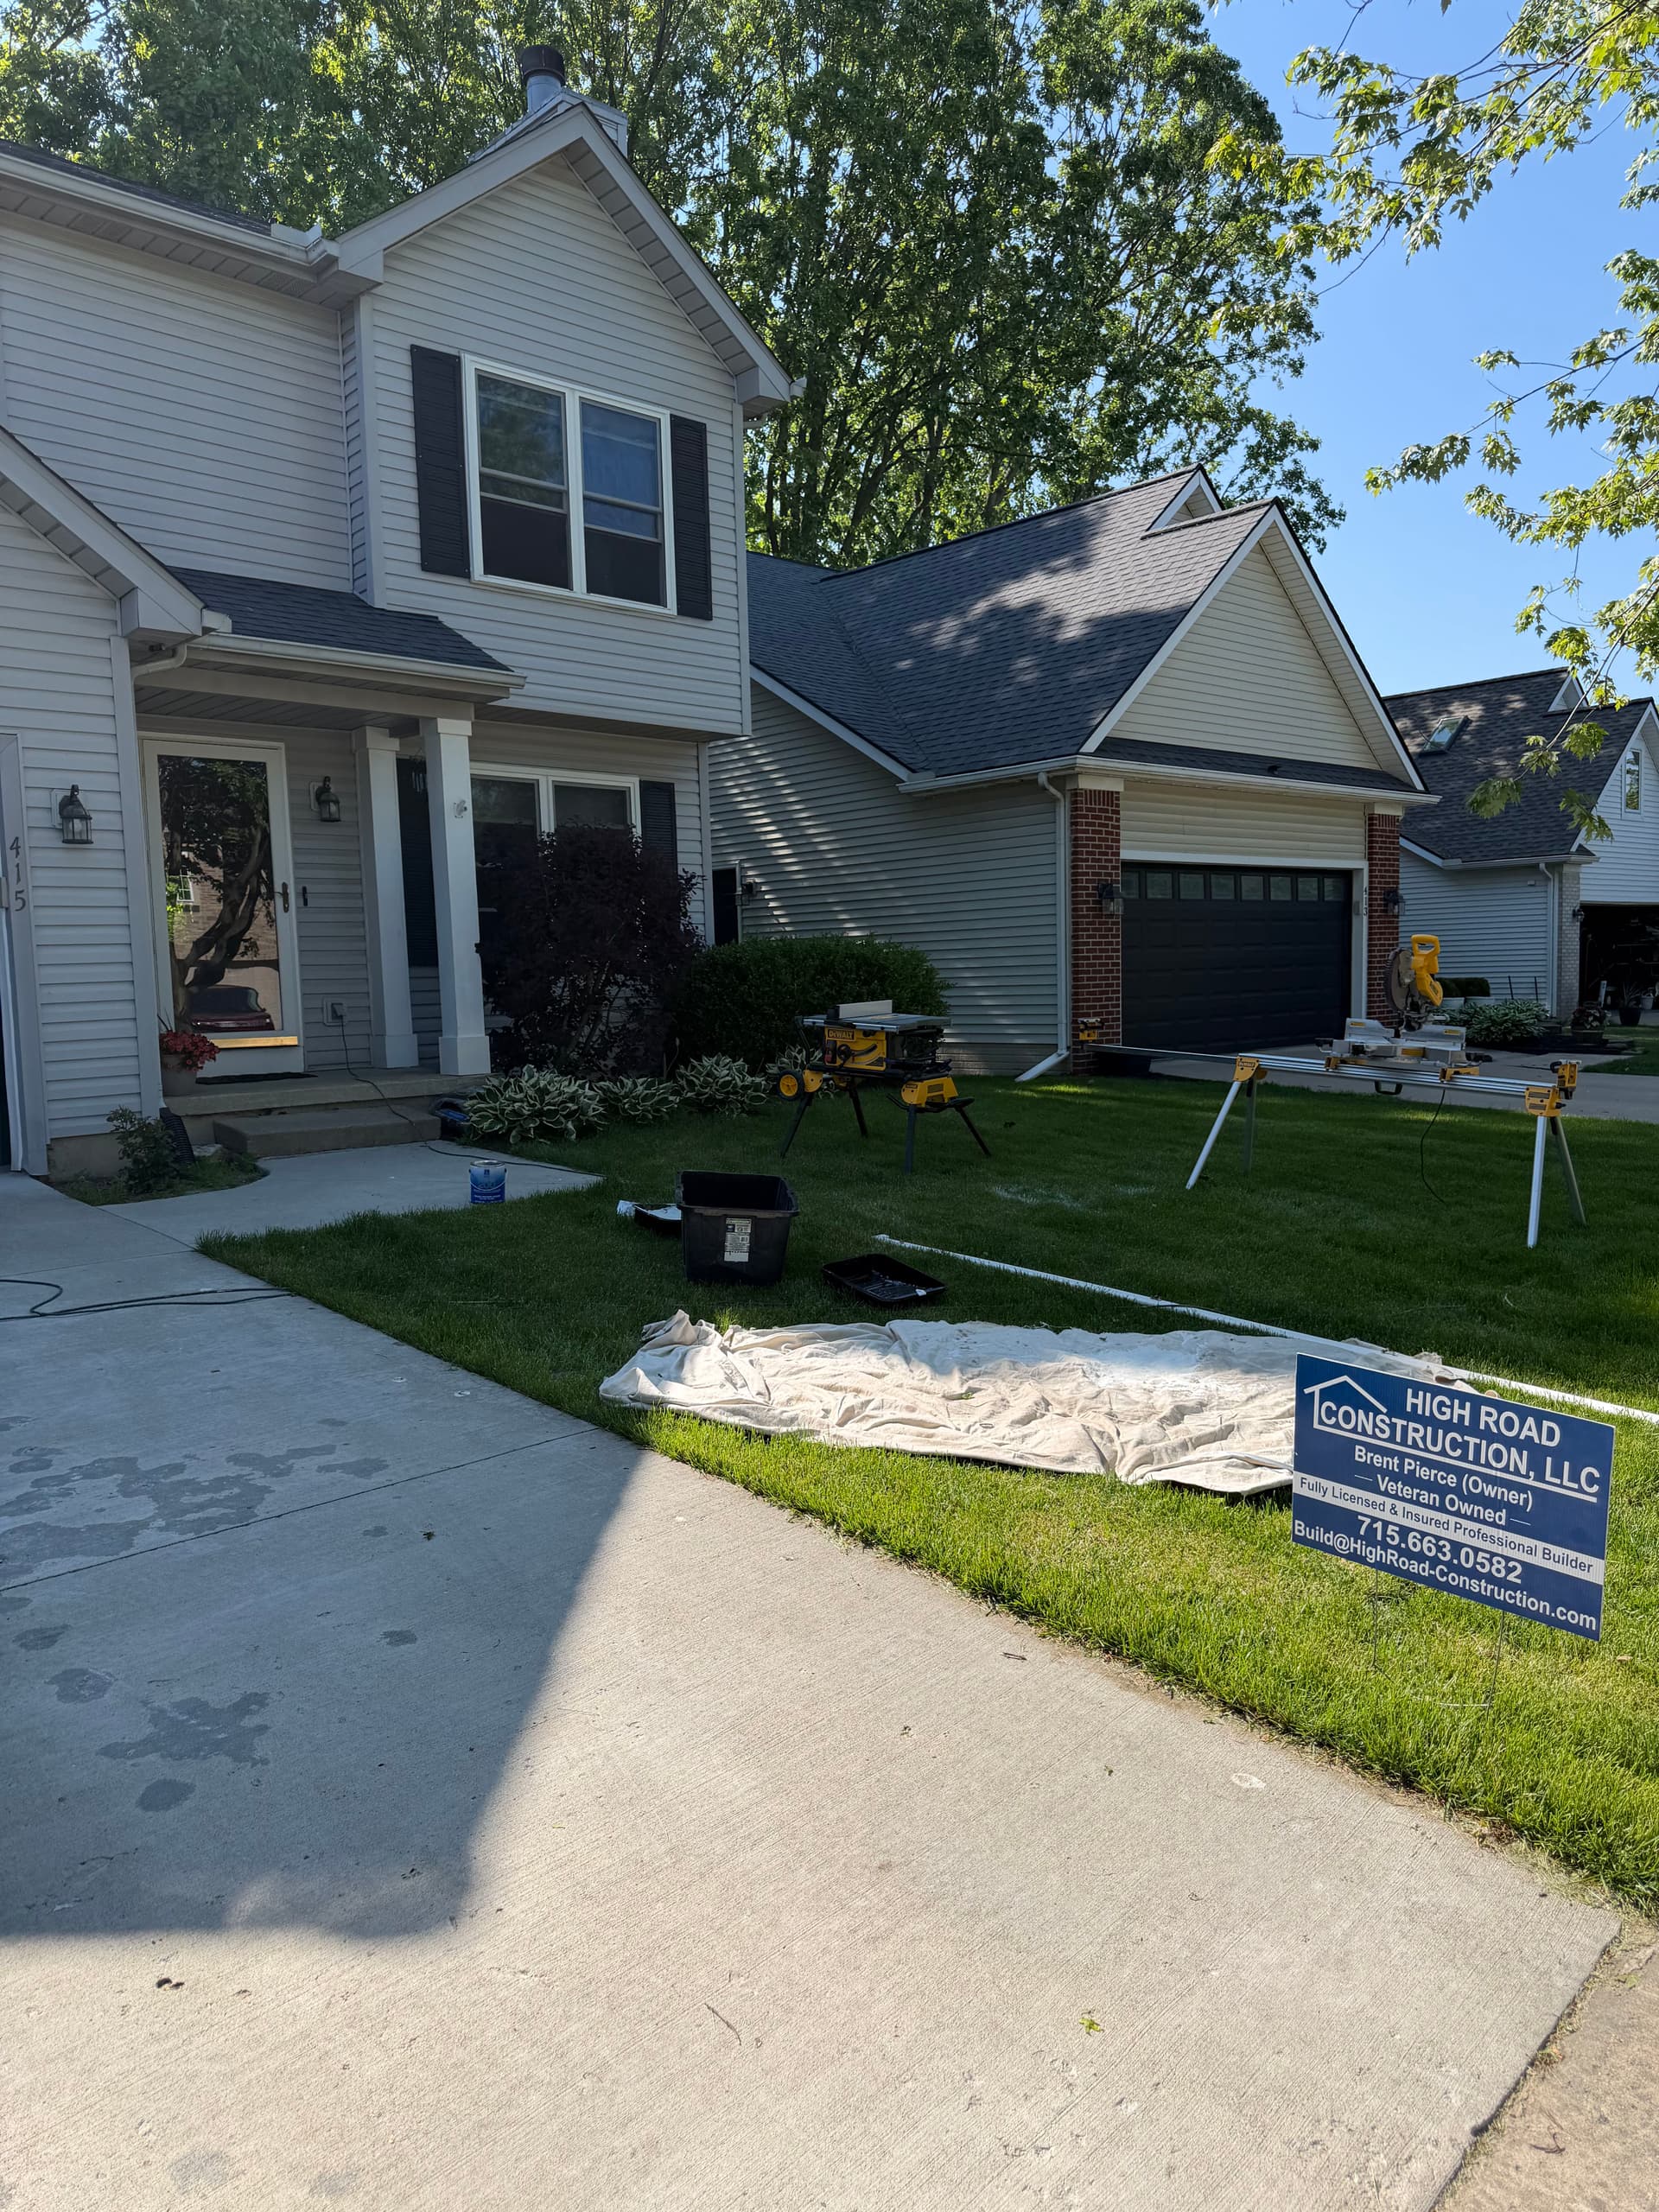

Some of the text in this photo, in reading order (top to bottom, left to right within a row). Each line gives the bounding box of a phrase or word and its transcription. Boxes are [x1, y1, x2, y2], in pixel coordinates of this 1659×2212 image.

[10, 836, 26, 912] 415
[1320, 1401, 1600, 1494] CONSTRUCTION, LLC
[1406, 1388, 1561, 1447] HIGH ROAD
[1354, 1445, 1533, 1512] Brent Pierce (Owner)
[1376, 1474, 1507, 1526] Veteran Owned
[1300, 1477, 1593, 1573] Fully Licensed & Insured Professional Builder
[1357, 1515, 1522, 1585] 715.663.0582
[1294, 1519, 1597, 1631] Build@HighRoad-Construction.com
